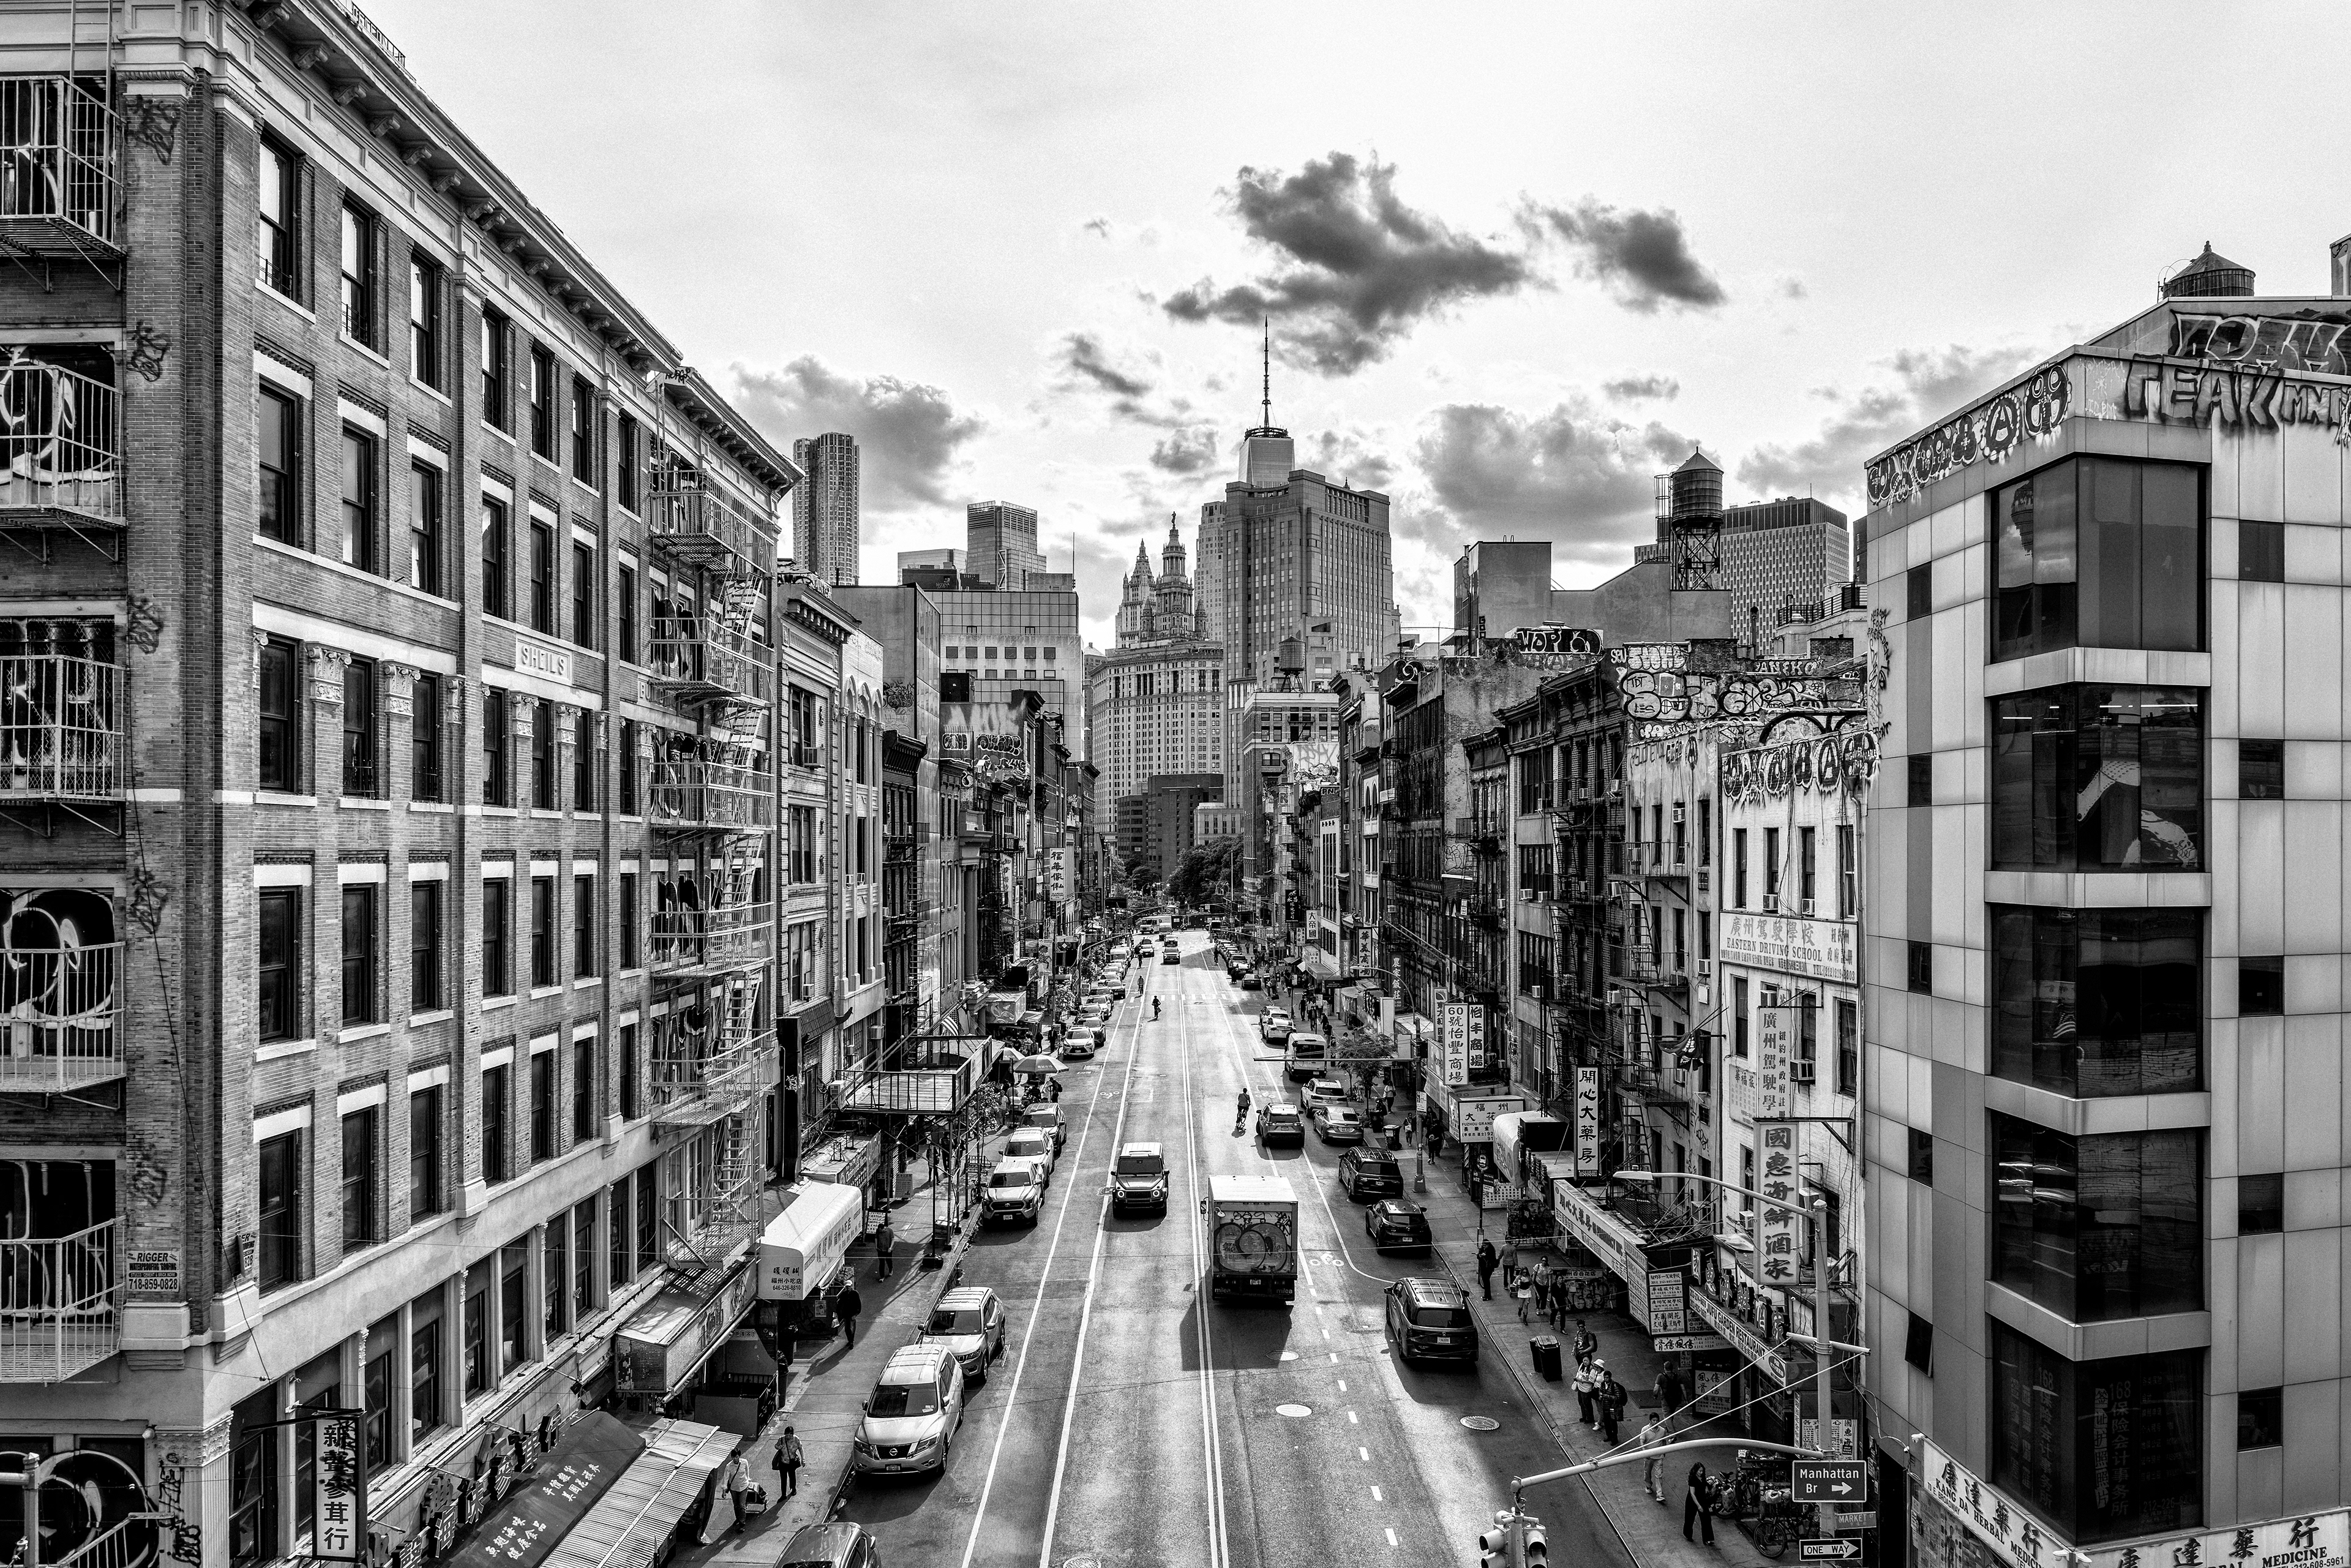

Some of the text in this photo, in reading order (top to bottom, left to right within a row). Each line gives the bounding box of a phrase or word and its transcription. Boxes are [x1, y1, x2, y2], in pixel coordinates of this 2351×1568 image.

[1727, 937, 1822, 962] EASTERN DRIVING SCHOOL
[1763, 1013, 1777, 1117] 廣州駕駛學
[1579, 1070, 1597, 1163] 開心大藥房
[137, 1253, 168, 1262] RIGGER
[129, 1278, 178, 1290] 718-859-0828
[1718, 1311, 1736, 1335] GARDEN
[1736, 1324, 1766, 1360] RESTAURANT
[1800, 1468, 1859, 1479] Manhattan
[1806, 1484, 1817, 1493] Br
[1938, 1491, 1960, 1515] BROADWAY
[1839, 1514, 1867, 1523] MARKET
[1935, 1478, 2044, 1568] KANG DA HERBAL MEDICIN
[506, 1520, 546, 1560] 健康食品
[1831, 1545, 1850, 1553] WAY
[2262, 1546, 2327, 1568] MEDICINE
